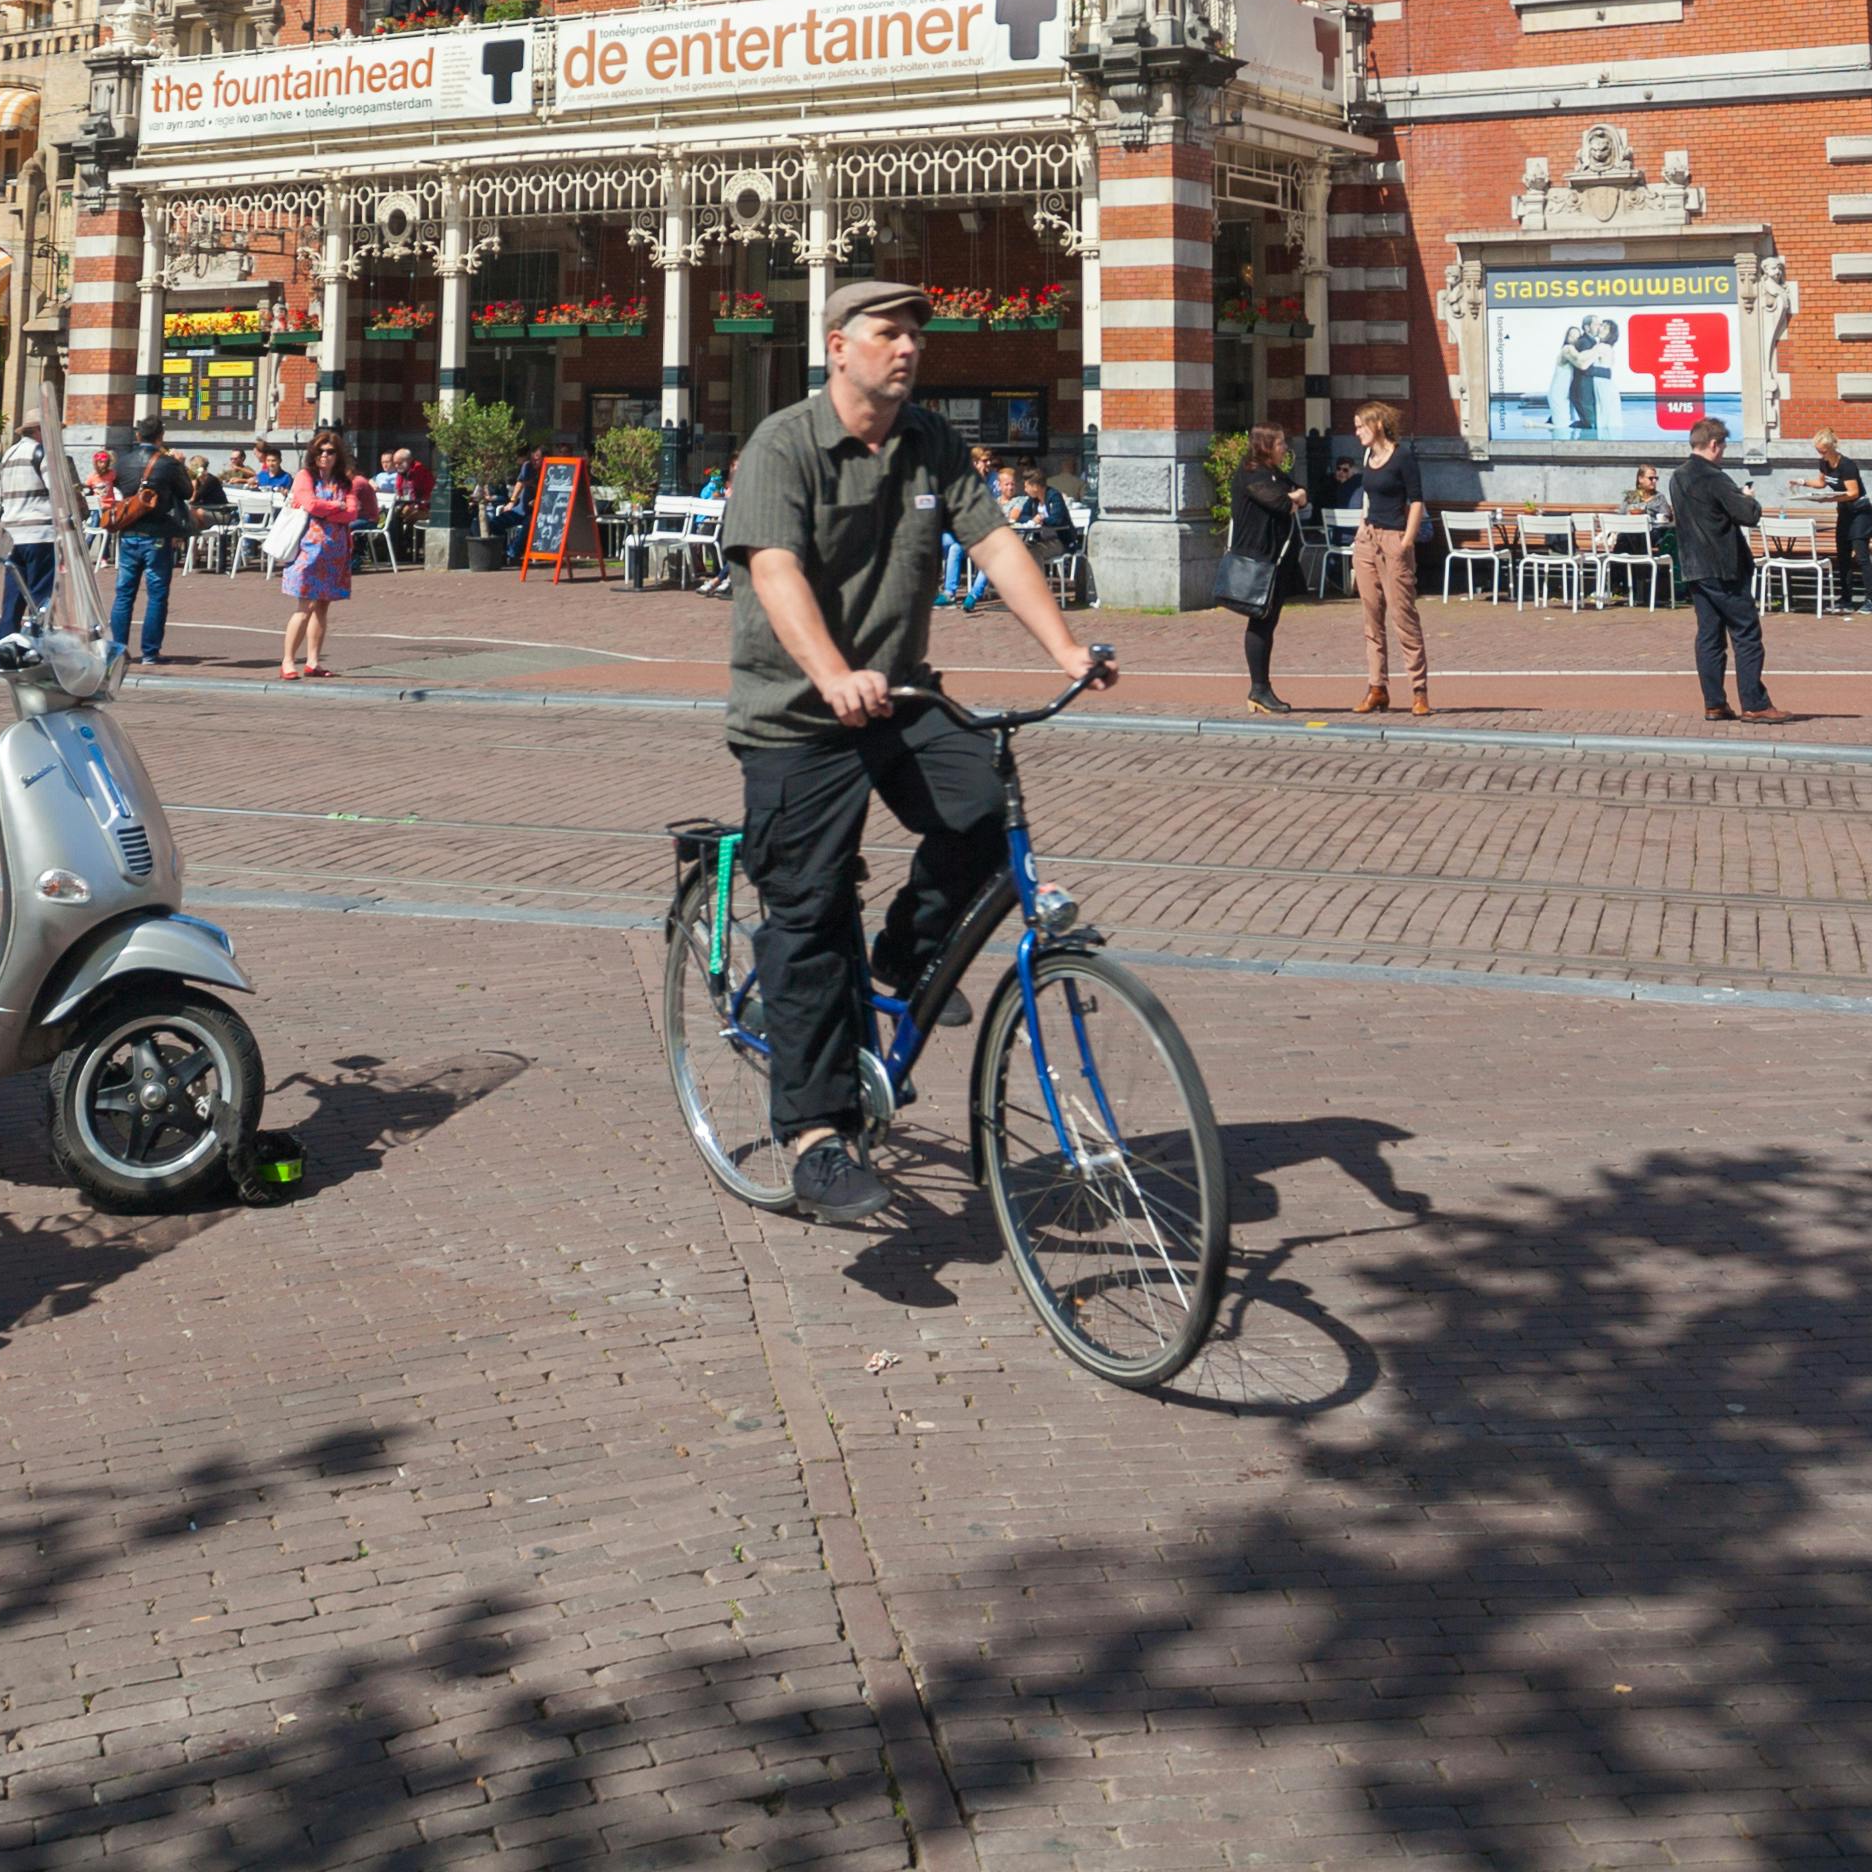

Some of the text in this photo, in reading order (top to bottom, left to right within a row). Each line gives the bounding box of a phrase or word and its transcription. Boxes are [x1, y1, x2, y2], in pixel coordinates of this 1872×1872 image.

[835, 4, 856, 15] john
[858, 0, 895, 10] osborne
[599, 17, 717, 39] toneelgroepamsterdam
[562, 4, 984, 89] de entertainer
[151, 75, 203, 113] the
[213, 47, 435, 108] fountainhead
[611, 88, 643, 99] aparicio
[673, 82, 690, 92] fred
[871, 63, 887, 77] gijs
[890, 62, 929, 73] scholten
[932, 60, 949, 69] van
[951, 56, 984, 67] aschat
[148, 121, 164, 131] van
[166, 120, 183, 132] ayn
[185, 118, 206, 129] rand
[236, 114, 249, 124] ivo
[252, 113, 268, 123] van
[270, 109, 292, 120] hove
[305, 98, 433, 118] toneelgroepamsterdam
[1668, 402, 1694, 413] 14/15
